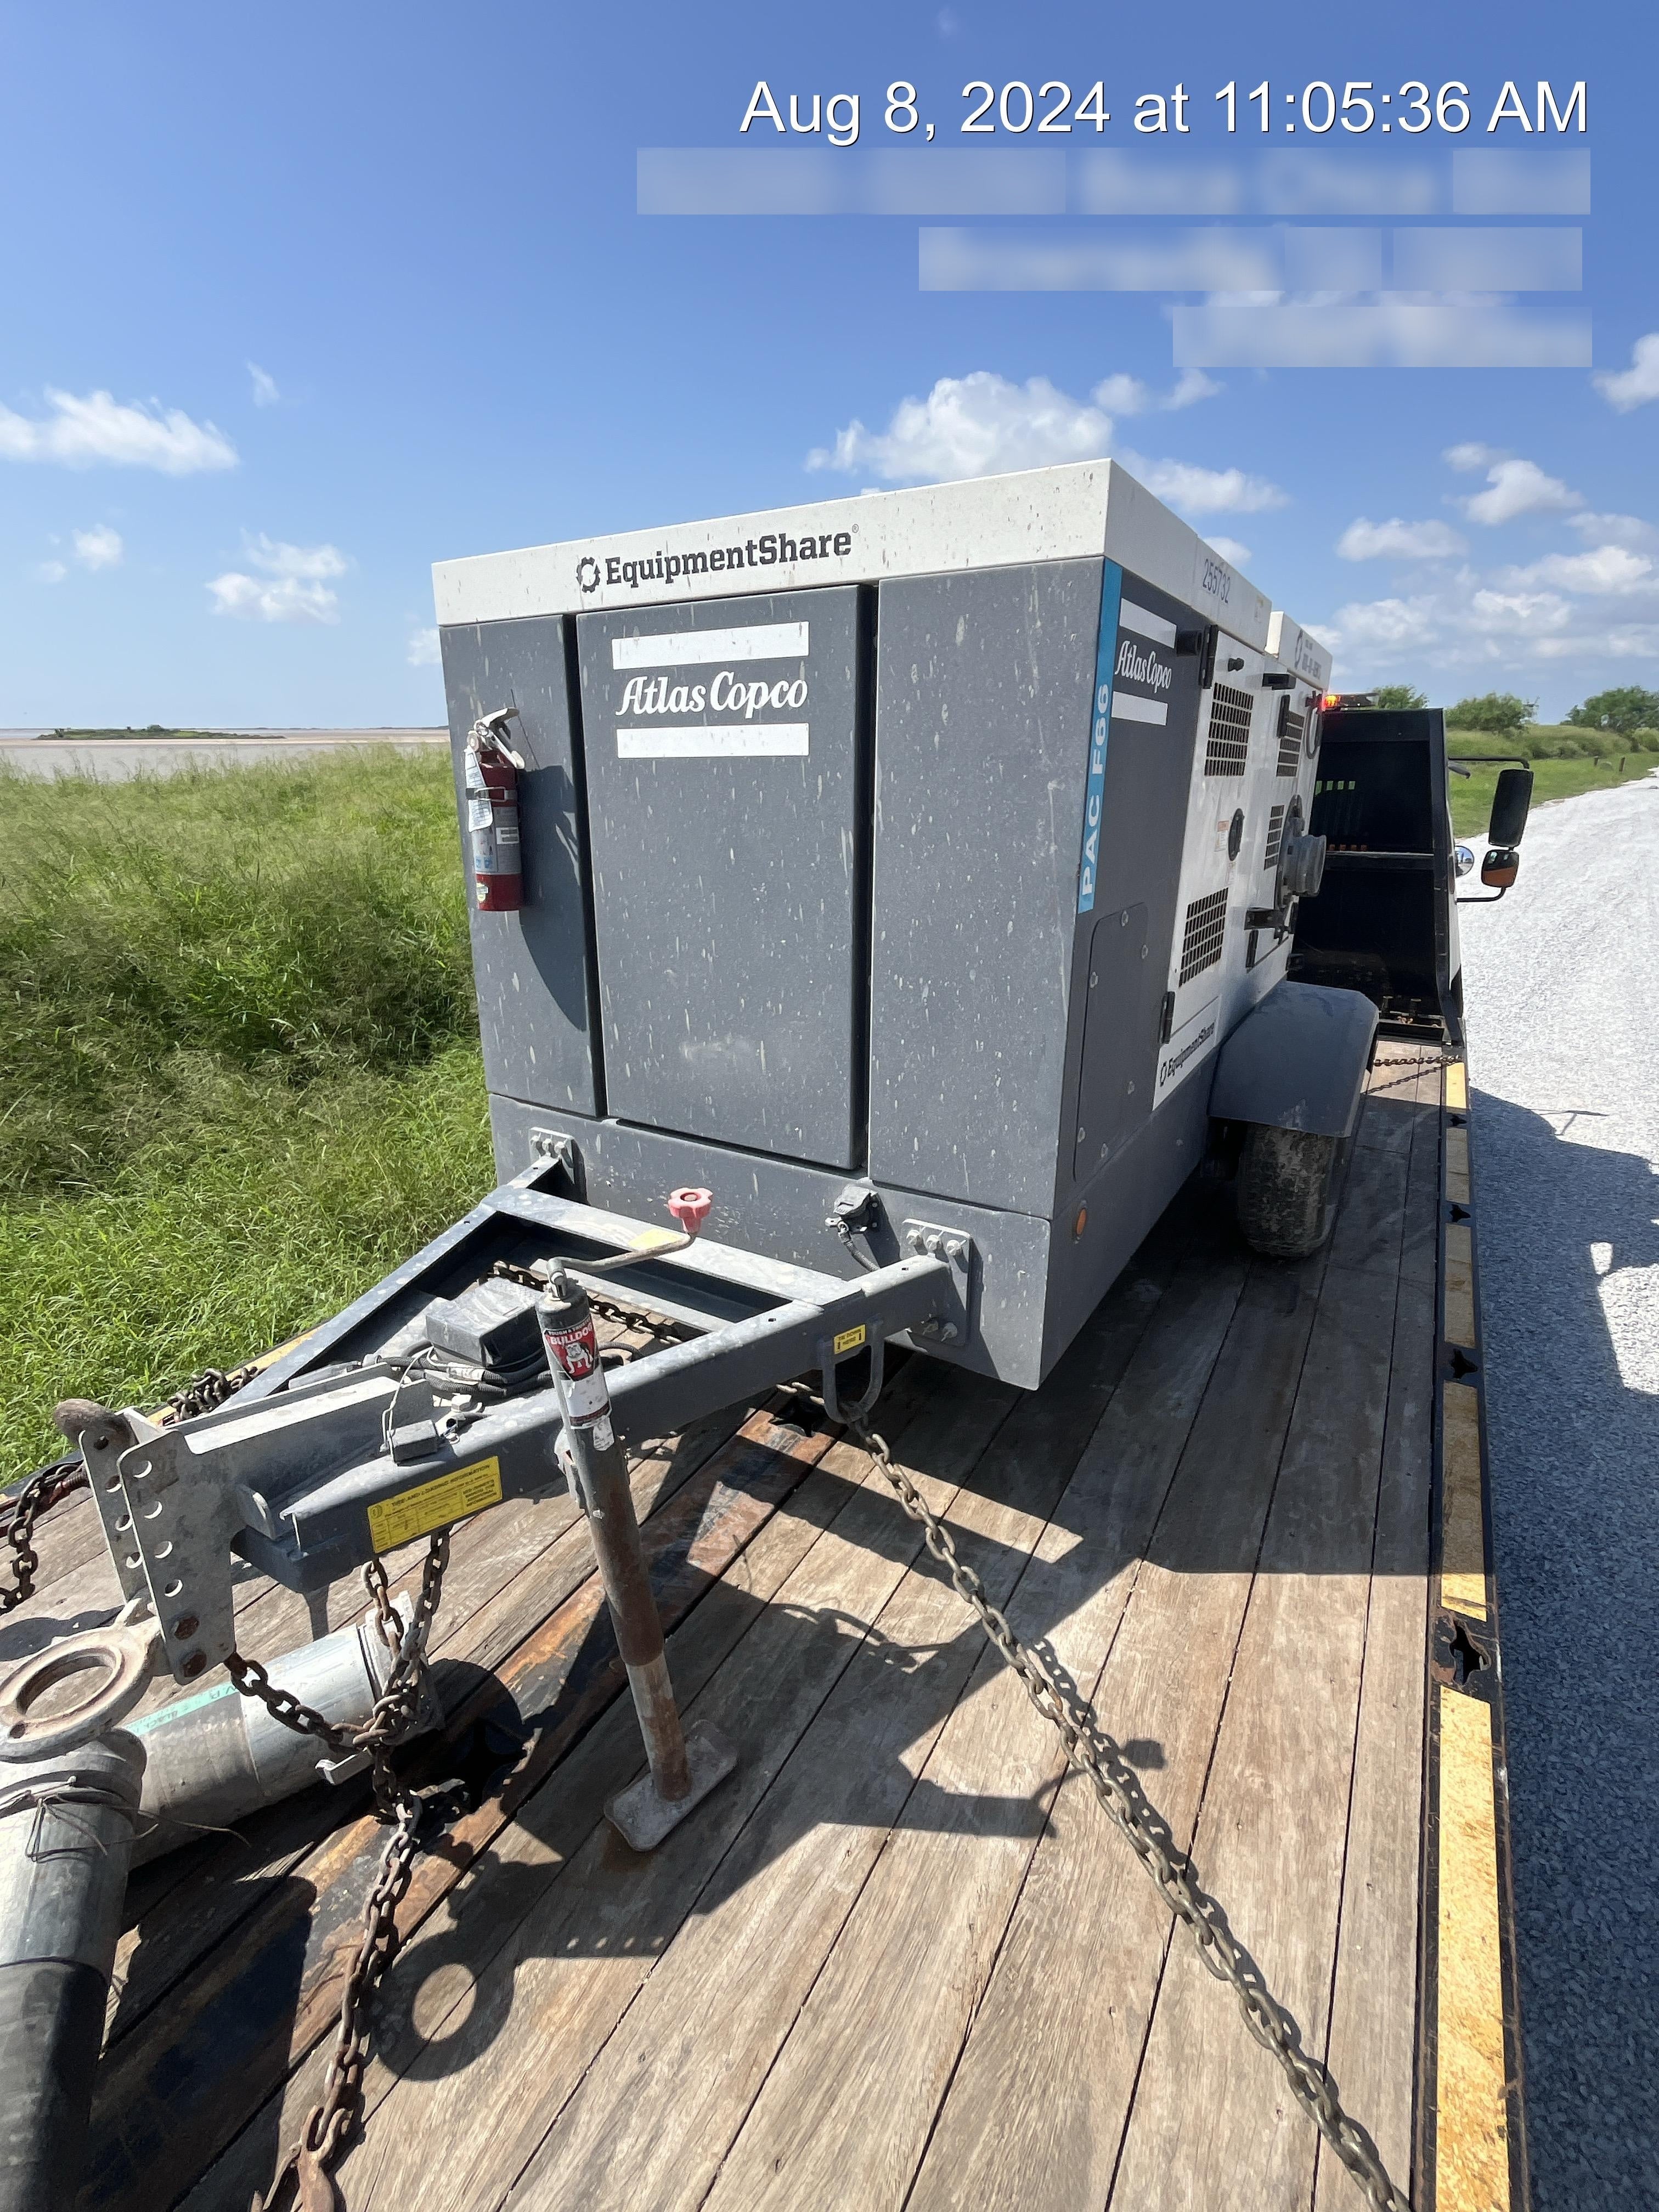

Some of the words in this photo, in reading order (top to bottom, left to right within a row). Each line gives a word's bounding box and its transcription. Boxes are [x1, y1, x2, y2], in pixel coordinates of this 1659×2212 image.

[1202, 558, 1231, 604] 255732
[1114, 640, 1147, 682] Atlas
[1146, 651, 1172, 693] Copco
[616, 675, 707, 716] Atlas
[710, 671, 808, 719] Copco
[1081, 795, 1101, 896] PAC
[1092, 684, 1109, 775] F66
[1167, 1023, 1215, 1077] EquipmentShare
